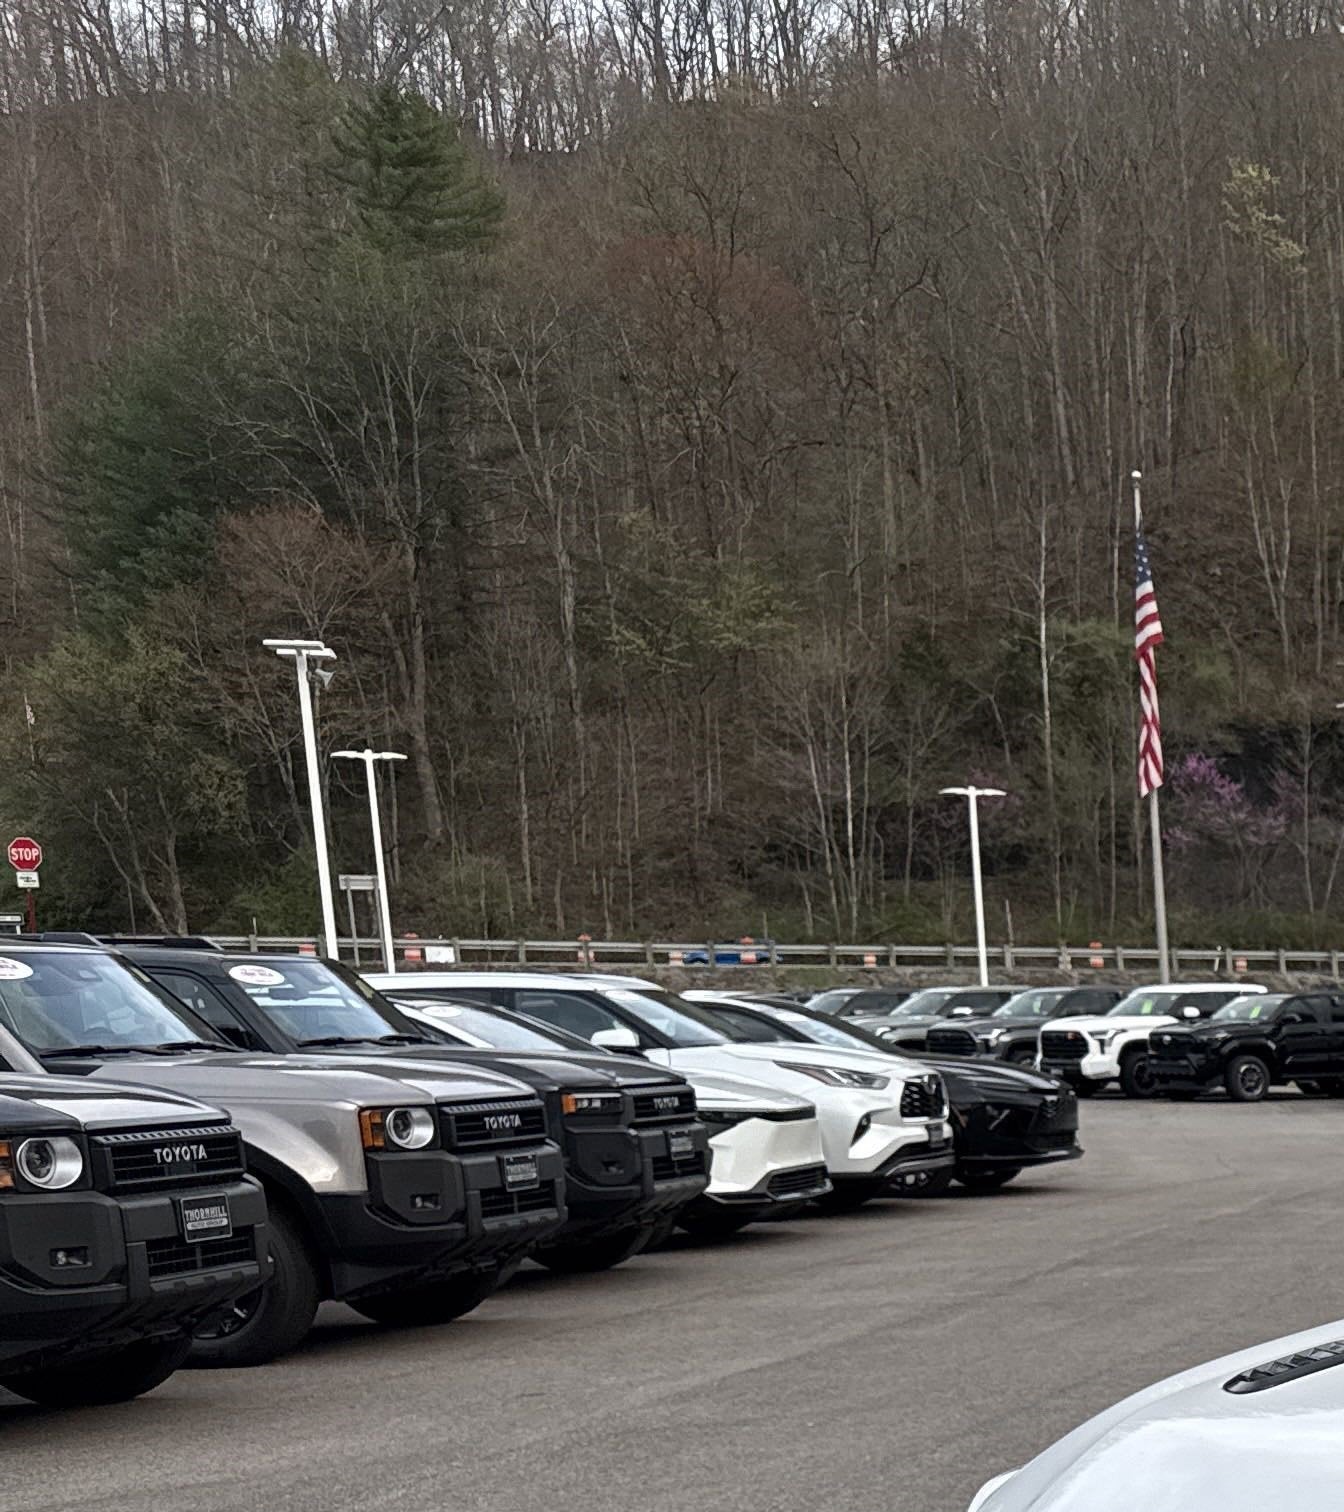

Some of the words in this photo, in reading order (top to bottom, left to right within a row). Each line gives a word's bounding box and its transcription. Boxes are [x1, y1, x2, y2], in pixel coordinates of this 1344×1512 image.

[11, 847, 40, 862] STOP
[483, 1114, 522, 1130] TOYOTA
[153, 1144, 208, 1164] TOYOTA
[184, 1205, 228, 1222] THORNHILL
